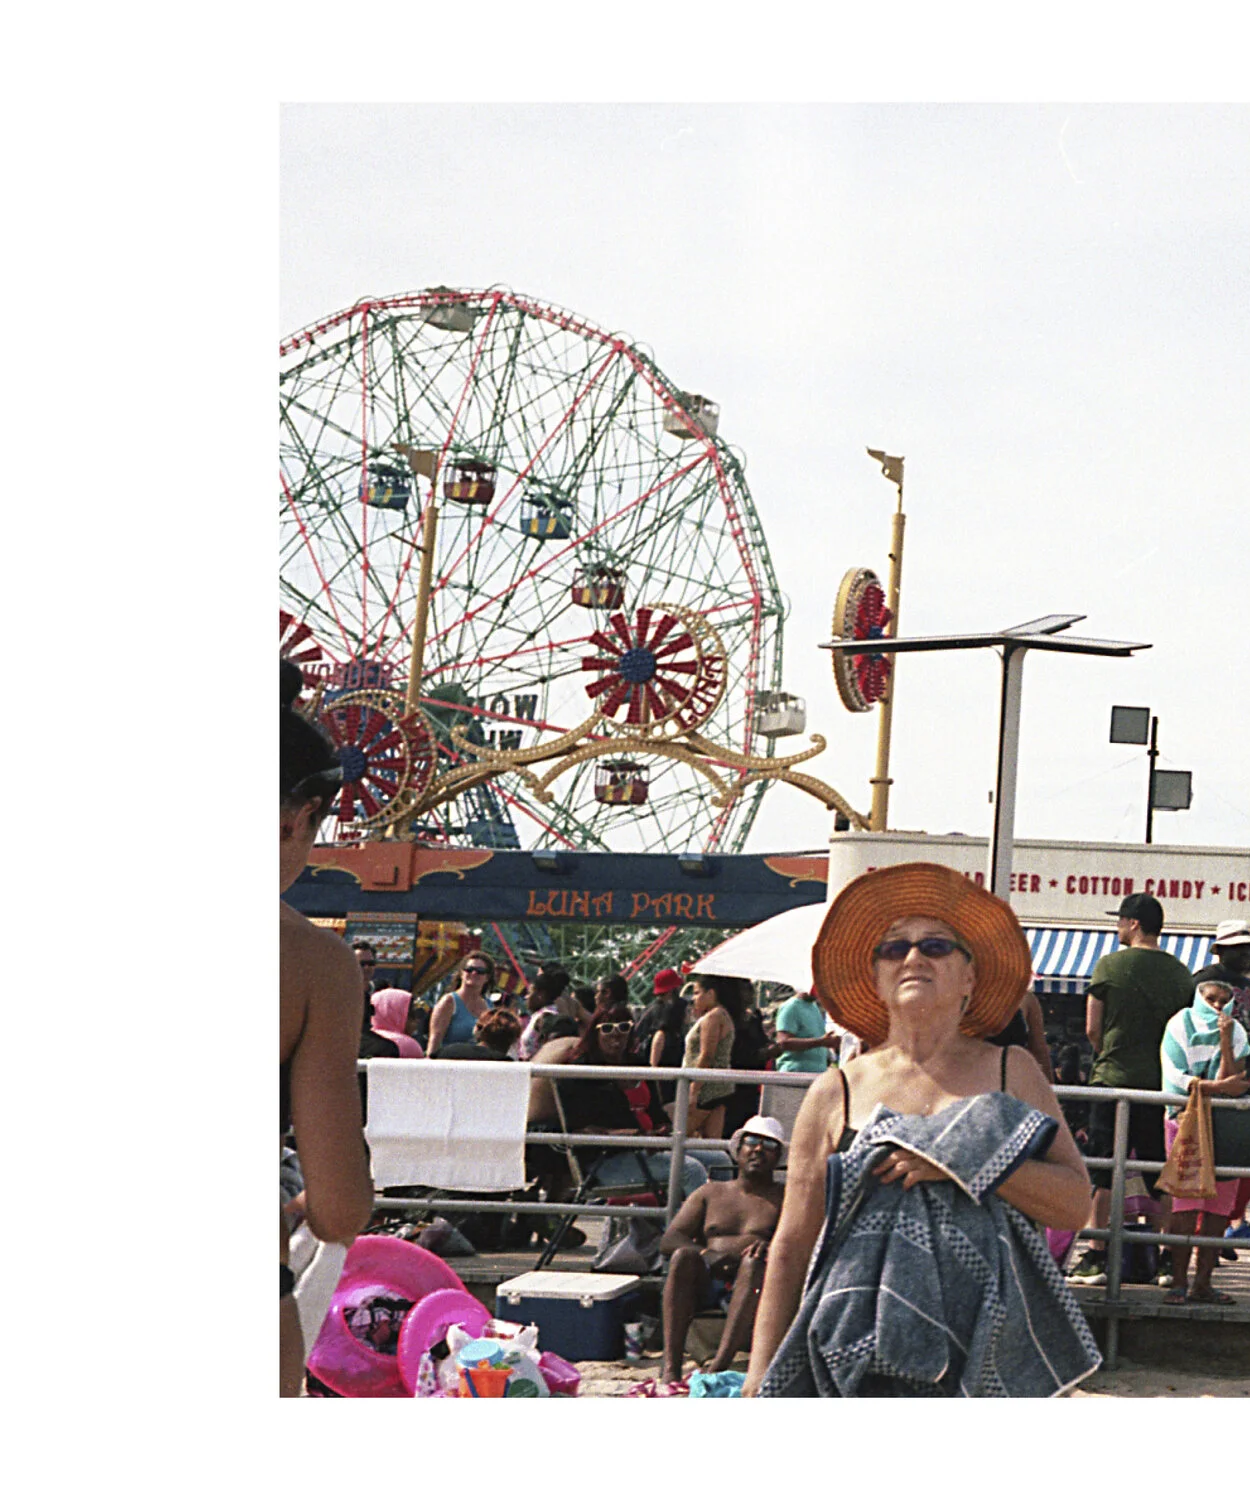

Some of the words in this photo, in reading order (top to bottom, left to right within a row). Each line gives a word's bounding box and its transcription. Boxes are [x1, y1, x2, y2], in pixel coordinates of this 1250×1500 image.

[1010, 873, 1041, 893] EER
[1066, 875, 1134, 896] COTTON
[1145, 878, 1206, 900] CANDY
[526, 889, 613, 917] LUNA
[630, 892, 717, 920] PARK
